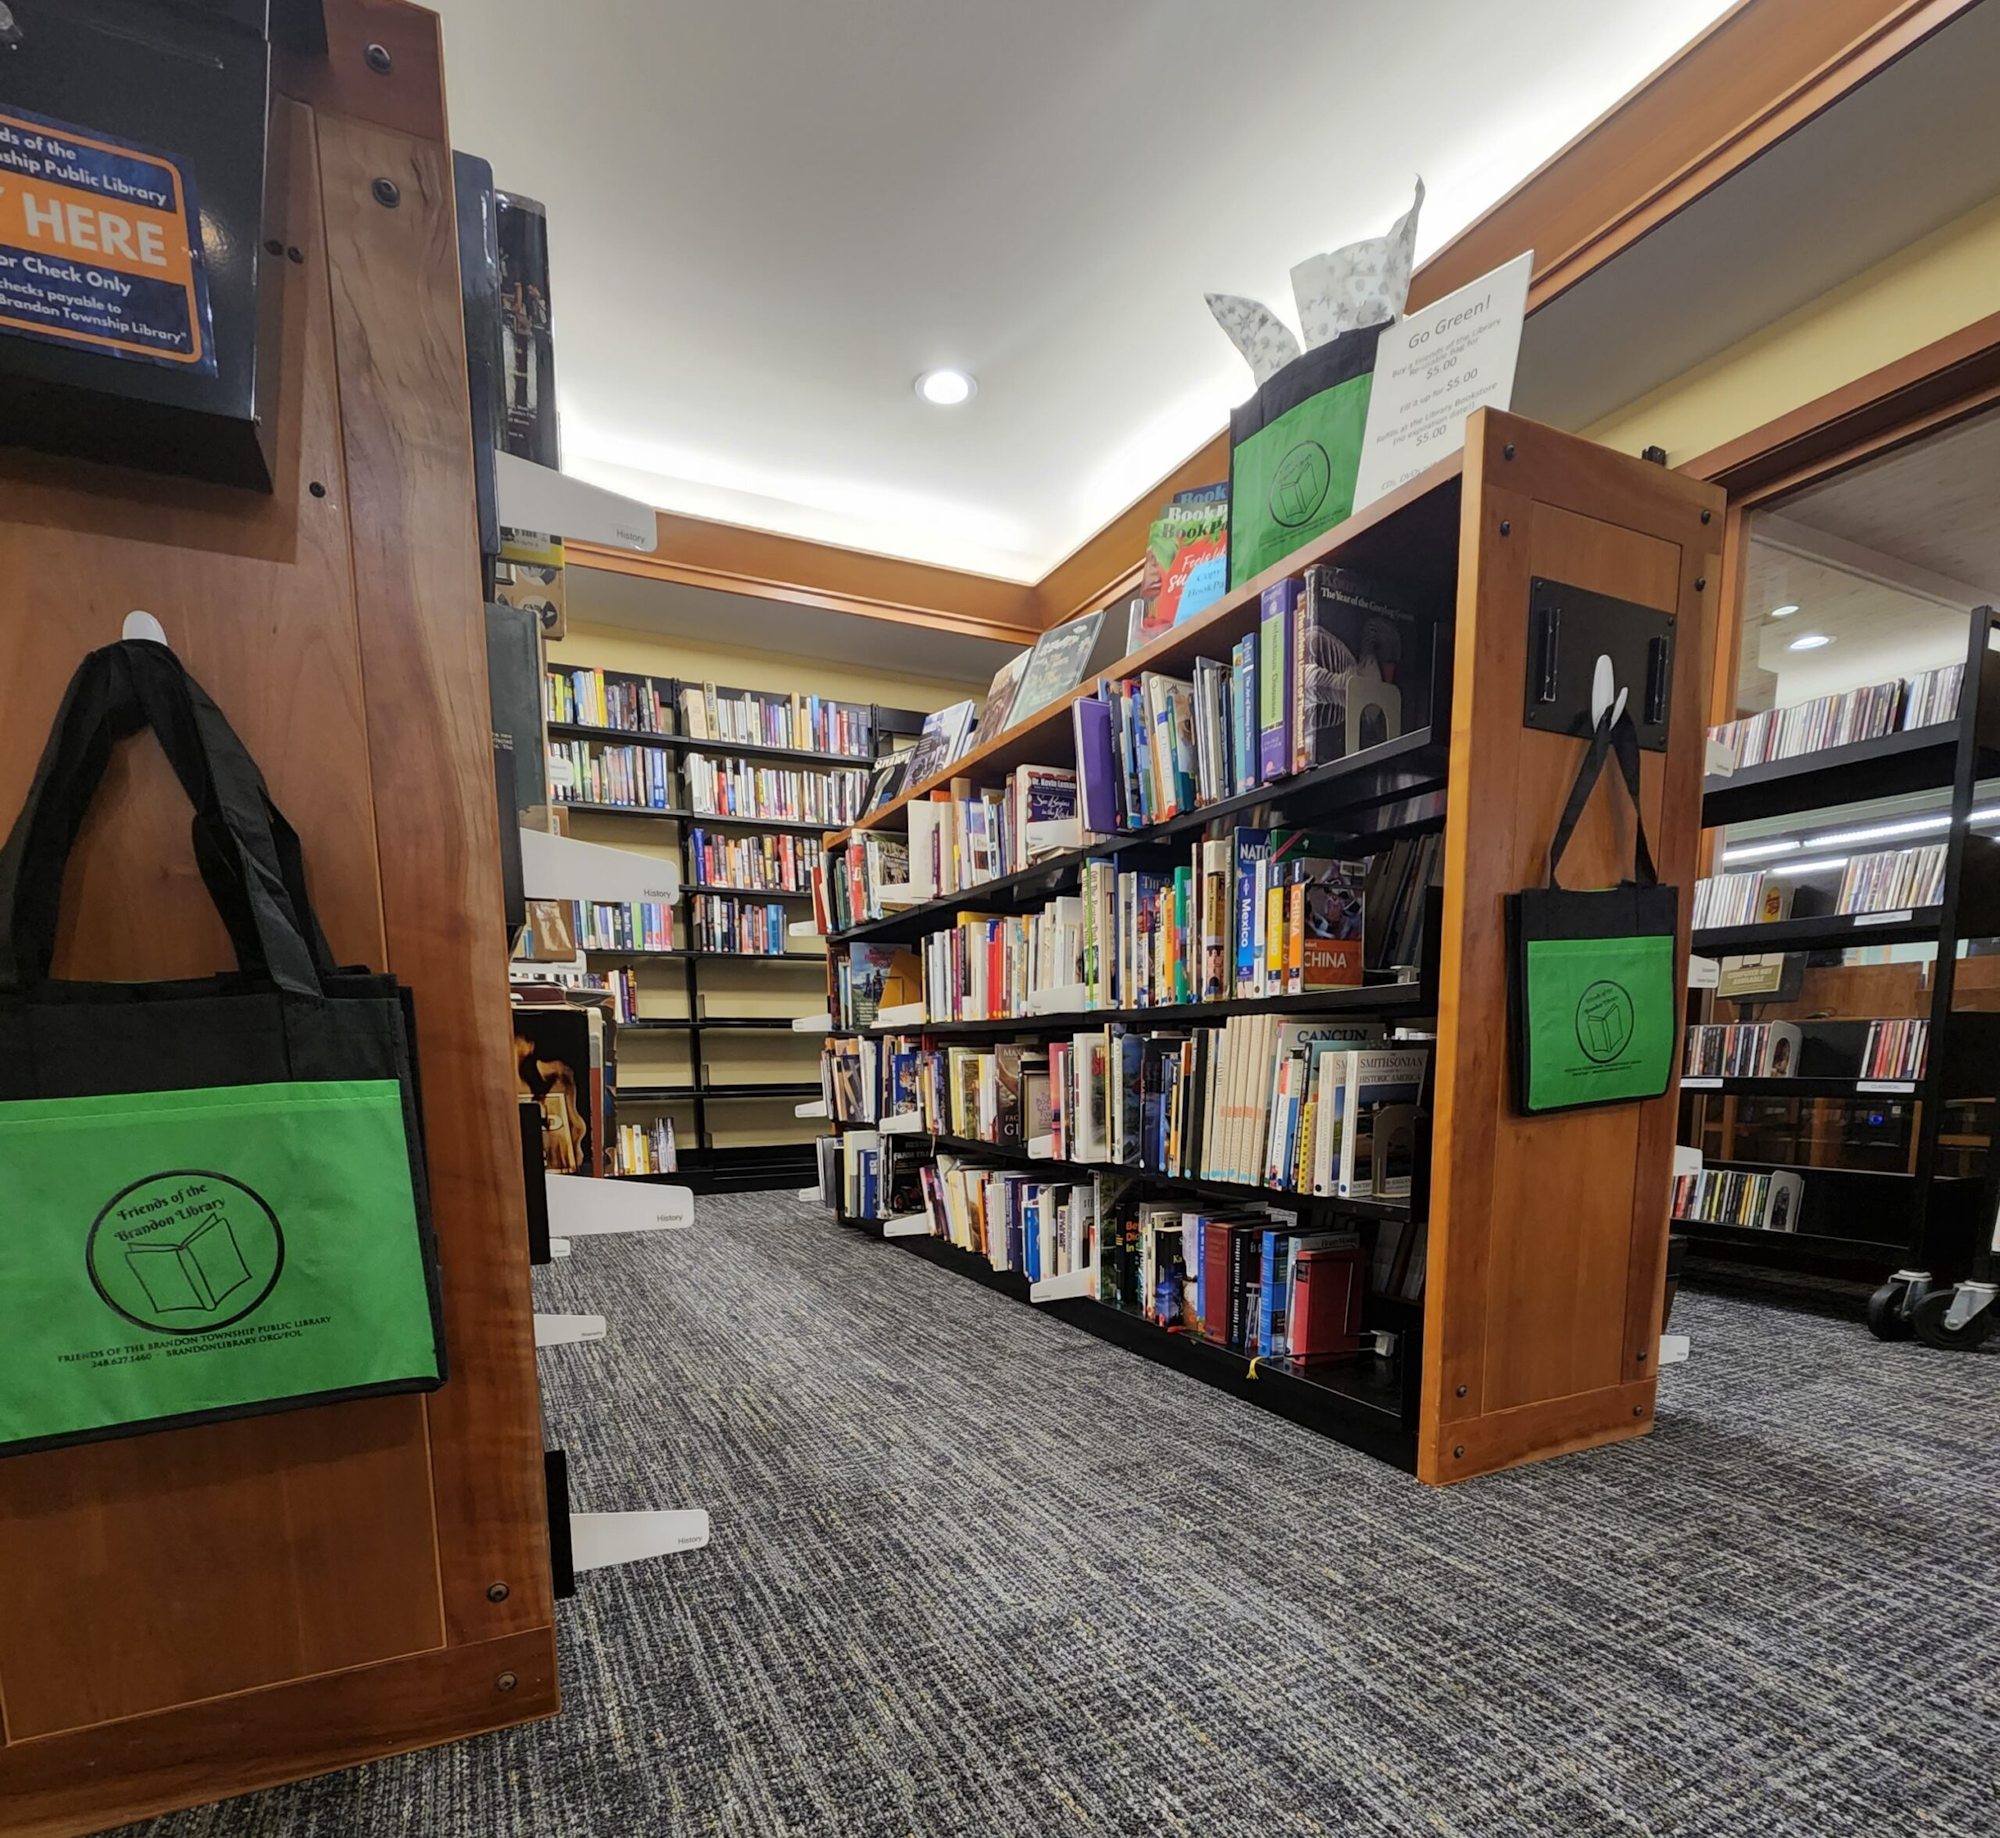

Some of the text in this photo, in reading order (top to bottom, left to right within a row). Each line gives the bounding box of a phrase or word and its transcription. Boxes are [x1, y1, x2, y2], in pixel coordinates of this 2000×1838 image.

[24, 137, 45, 152] of
[47, 140, 77, 161] the
[45, 159, 99, 187] Public
[103, 175, 167, 207] Library
[22, 191, 167, 267] HERE
[22, 257, 82, 284] Check
[86, 271, 131, 297] Only
[47, 287, 105, 312] payable
[107, 301, 122, 315] to
[63, 307, 130, 333] Township
[1408, 294, 1491, 349] Go Green!
[1392, 366, 1406, 378] Buy
[1414, 347, 1443, 366] Friends
[1445, 340, 1455, 351] of
[1456, 333, 1469, 345] the
[1472, 318, 1501, 338] Library
[1466, 337, 1479, 348] for
[1426, 356, 1457, 380] $5.00
[1400, 368, 1478, 414] Fill it up for $5.00
[1376, 381, 1498, 444] Refills at the Library Bookstore
[1407, 416, 1448, 439] expiration
[1415, 425, 1447, 447] $5.00
[616, 528, 646, 544] History
[1320, 587, 1336, 600] The
[1336, 590, 1350, 603] Year
[1350, 595, 1359, 605] of
[1358, 597, 1368, 609] the
[1297, 609, 1305, 629] The
[1297, 630, 1305, 660] White
[1271, 621, 1279, 719] Infectious Diseases
[1297, 661, 1305, 686] Lions
[1297, 687, 1305, 698] of
[1032, 777, 1076, 788] Dr. Kevin Leman
[643, 888, 671, 899] History
[1240, 898, 1251, 948] Mexico
[1271, 894, 1279, 957] SCOTLAND
[1291, 890, 1299, 937] CHINA
[1304, 950, 1347, 968] CHINA
[1728, 969, 1760, 979] COMPUTER
[1732, 975, 1765, 985] AVAILABLE
[1297, 1029, 1368, 1043] CANCUN
[1360, 1057, 1423, 1069] SMITHSONIAN
[1359, 1073, 1421, 1083] HISTORIC AMERICA
[117, 1183, 208, 1221] Friends of the
[114, 1196, 226, 1243] Brandon Library
[656, 1214, 683, 1223] History
[58, 1316, 332, 1363] FRIENDS OF THE BRANDON TOWNSHIP PUBLIC LIBRARY
[165, 1331, 303, 1357] BRANDONLIBRARY.ORG/FOL
[678, 1536, 703, 1545] History
